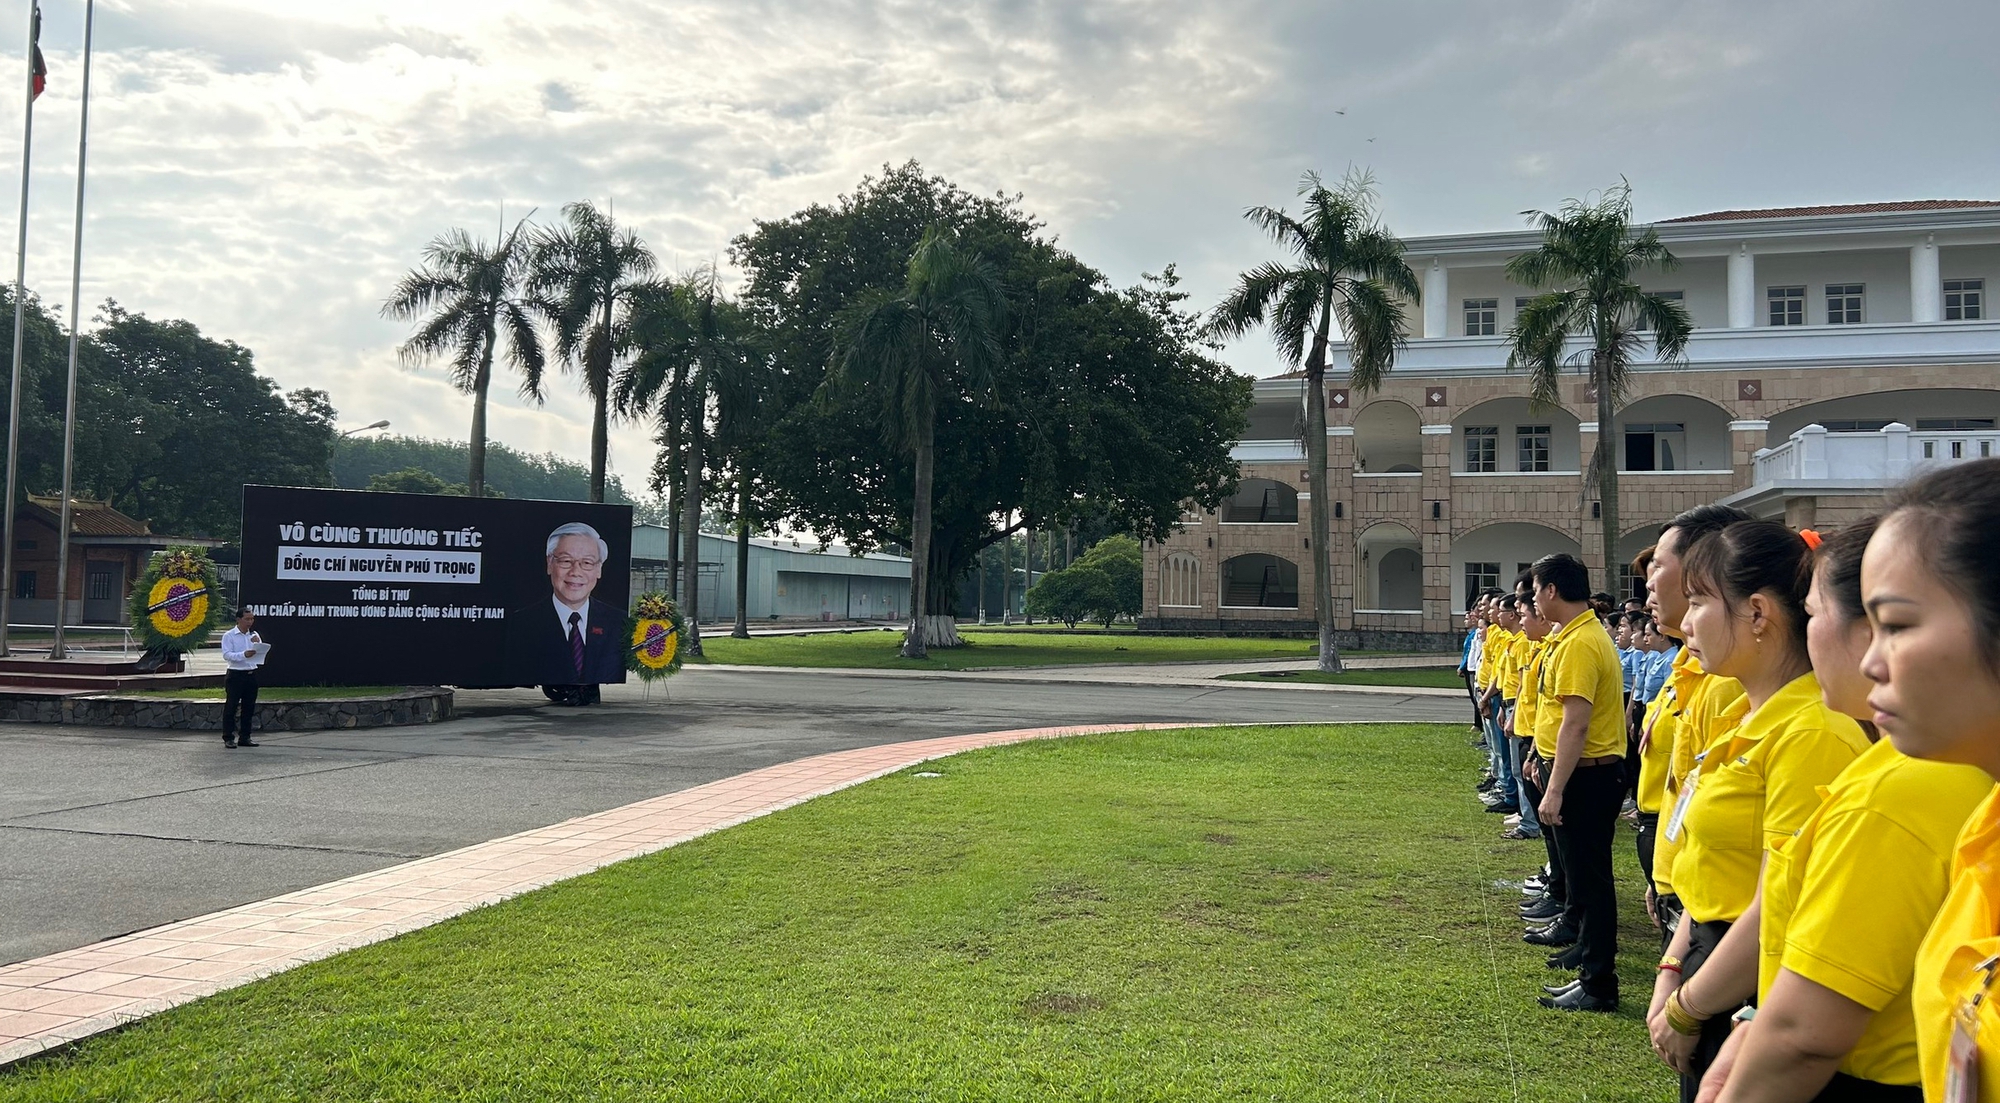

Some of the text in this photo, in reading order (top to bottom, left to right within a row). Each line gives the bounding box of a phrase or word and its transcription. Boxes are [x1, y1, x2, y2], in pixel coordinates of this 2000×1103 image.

[279, 521, 483, 547] VÔ CÙNG THƯƠNG TIẾC
[284, 552, 476, 579] ĐỒNG CHÍ NGUYỄN PHÚ TRỌNG
[352, 584, 411, 601] TỔNG BÍ THƯ
[269, 601, 296, 616] CHẤP
[298, 602, 325, 617] HÀNH
[327, 606, 359, 617] TRUNG
[361, 605, 386, 618] ƯƠNG
[388, 603, 414, 618] ĐẢNG
[416, 604, 440, 622] CỘNG
[442, 604, 461, 618] SẢN
[462, 605, 483, 622] VIỆT
[484, 608, 505, 619] NAM
